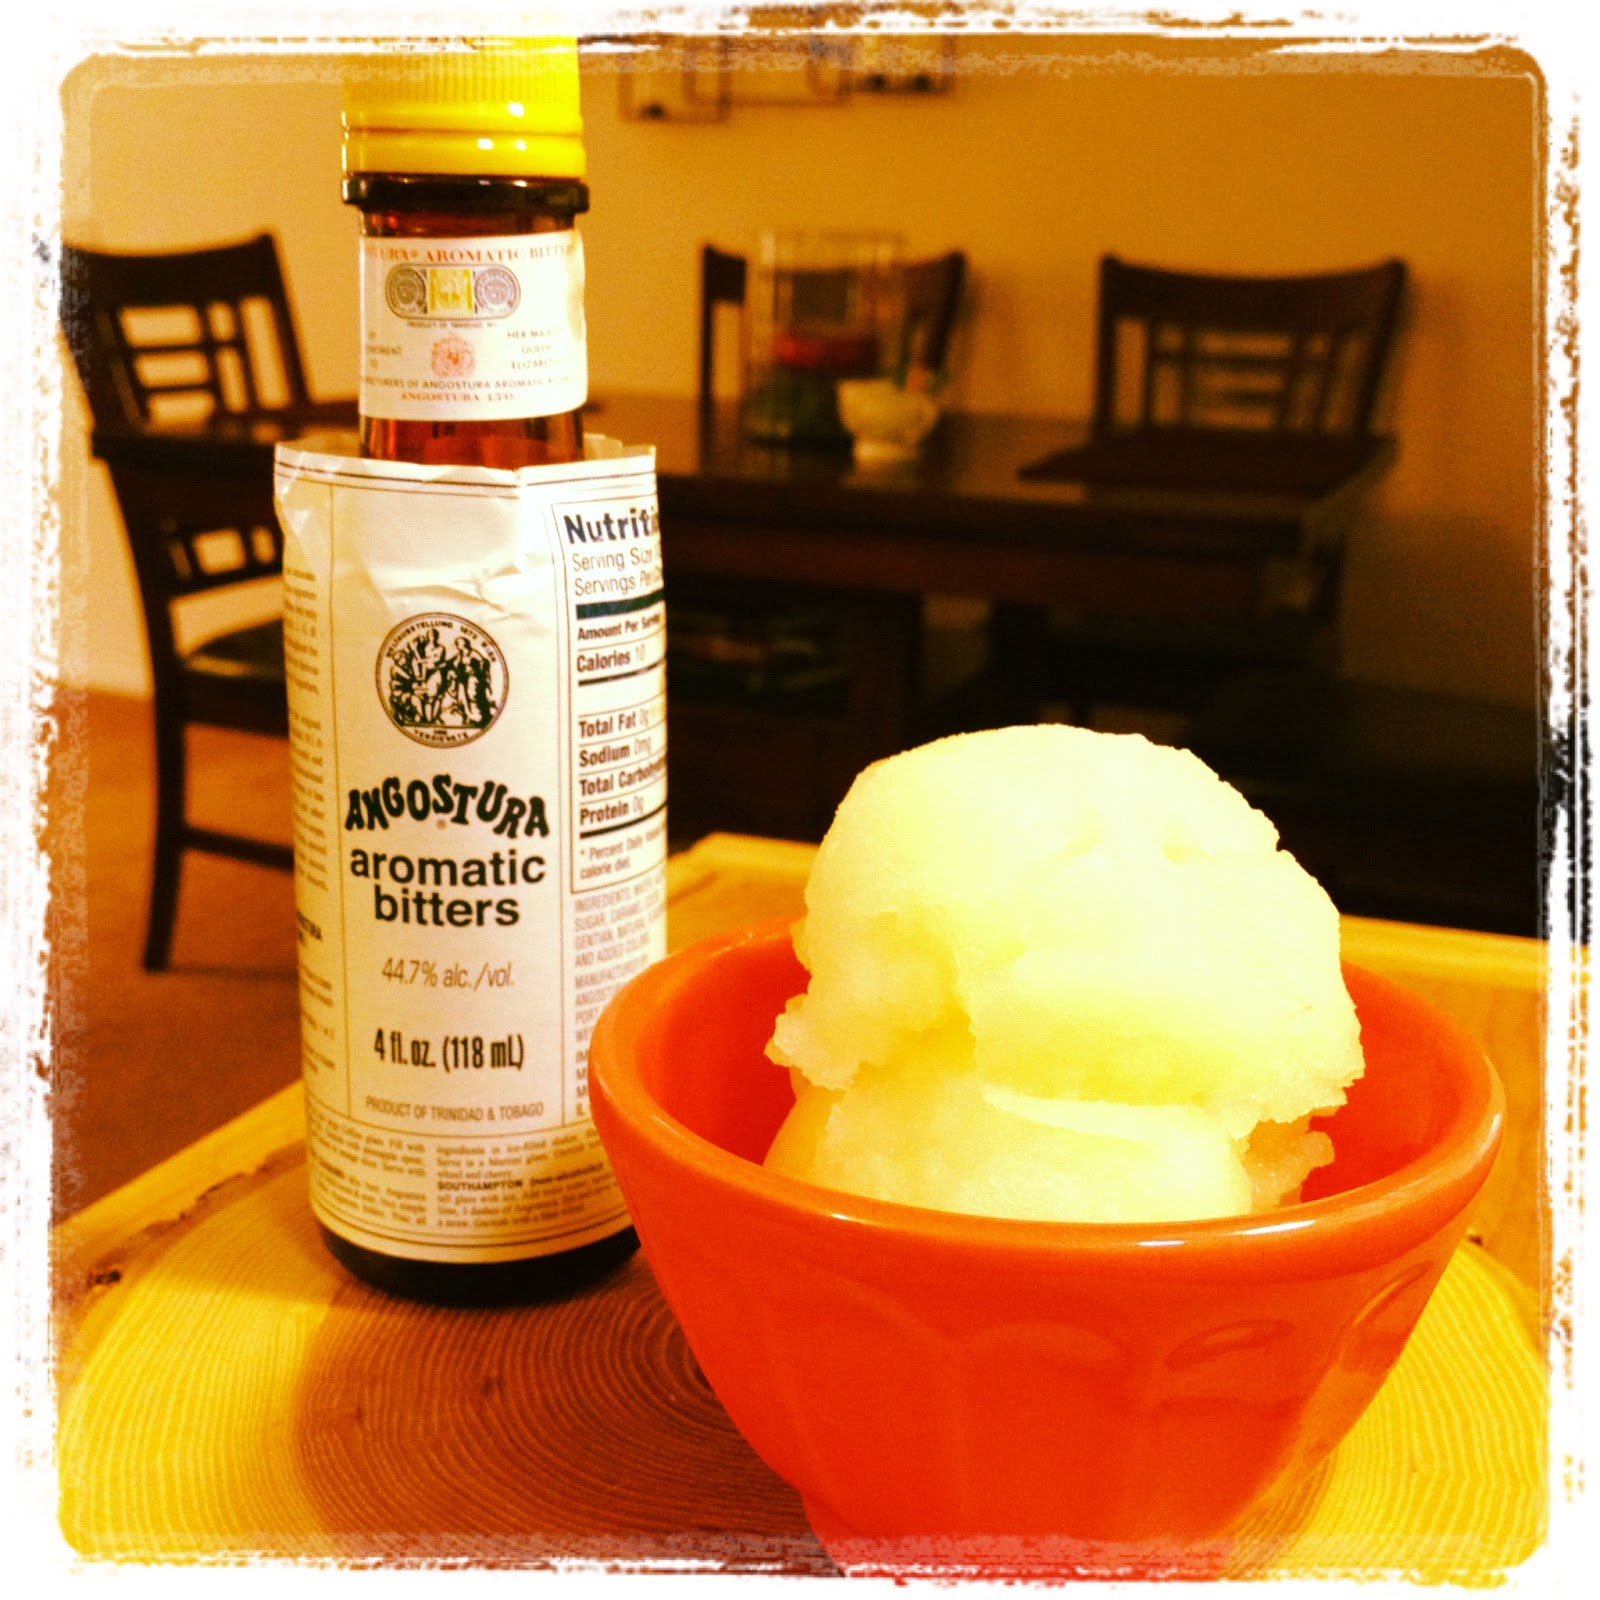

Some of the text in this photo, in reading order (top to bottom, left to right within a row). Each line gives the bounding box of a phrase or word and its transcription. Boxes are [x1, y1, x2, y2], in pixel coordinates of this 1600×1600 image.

[427, 247, 520, 263] AROMATIC
[506, 328, 528, 340] HER
[407, 379, 419, 389] OF
[422, 380, 493, 391] ANGOSTURA
[401, 392, 481, 402] ANGOSTURA
[572, 552, 626, 572] Serving
[574, 574, 637, 597] Servings
[577, 623, 622, 642] Amount
[625, 619, 639, 633] Per
[577, 649, 631, 673] Calories
[578, 717, 613, 740] Total
[618, 710, 637, 732] Fat
[579, 744, 631, 768] Sodium
[580, 775, 614, 797] Total
[345, 774, 549, 839] ANGOSTURA
[580, 800, 629, 826] Protein
[589, 841, 624, 861] Percent
[351, 848, 546, 887] aromatic
[580, 863, 612, 882] calorie
[375, 884, 519, 927] bitters
[382, 956, 515, 992] 44.7% alc./vol.
[374, 1027, 525, 1073] 4 fl. oz. (118 mL)
[365, 1095, 545, 1121] PRODUCT OF TRINIDAD & TOBAGO
[437, 1179, 523, 1190] SOUTHAMPTON
